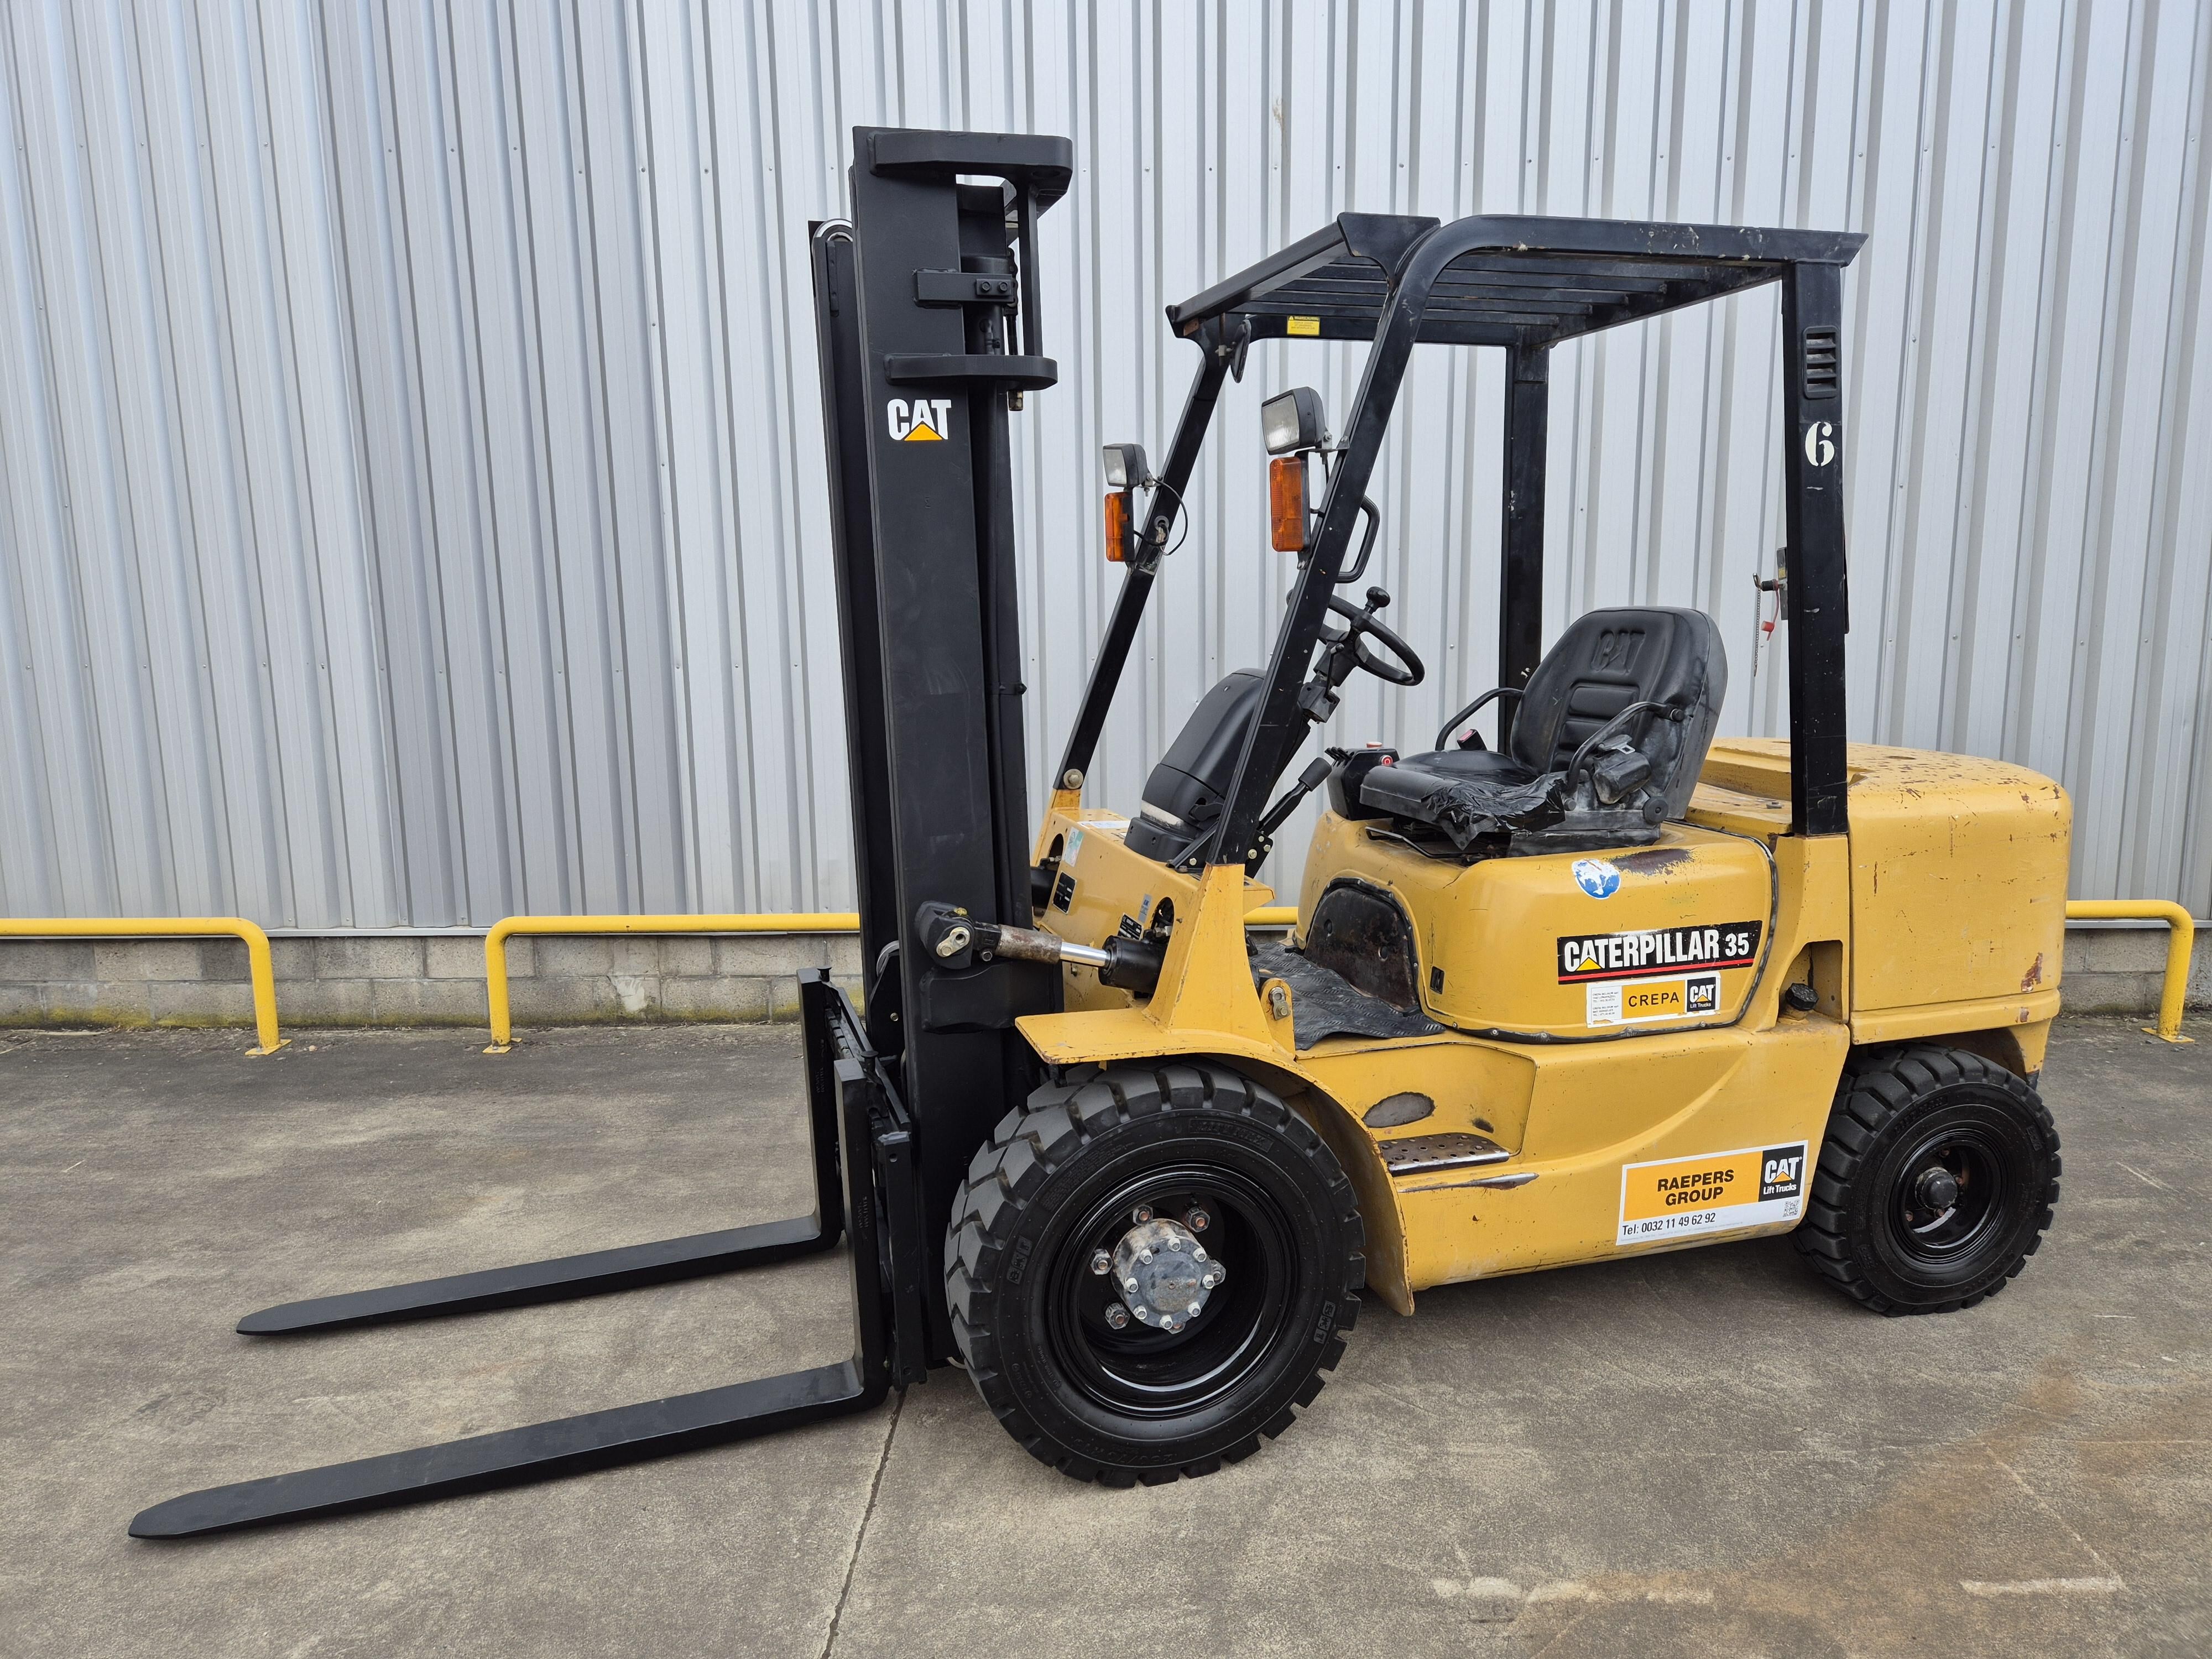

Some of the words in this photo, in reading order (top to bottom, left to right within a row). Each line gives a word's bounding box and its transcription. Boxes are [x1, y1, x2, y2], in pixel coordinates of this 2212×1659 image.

[886, 398, 952, 441] CAT
[1805, 421, 1835, 467] 6
[1590, 628, 1646, 675] CAT
[1564, 929, 1720, 972] CATERPILLAR
[1725, 932, 1750, 957] 35
[1629, 992, 1679, 1007] CREPA
[1689, 984, 1714, 1003] CAT
[1657, 1169, 1734, 1192] RAEPERS
[1764, 1157, 1799, 1183] CAT
[1665, 1186, 1724, 1206] GROUP
[1763, 1185, 1774, 1195] Lift
[1775, 1183, 1797, 1193] Trucks
[1623, 1225, 1639, 1235] Tel:
[1641, 1220, 1663, 1233] 0032
[1666, 1218, 1675, 1229] 11
[1678, 1217, 1689, 1227] 49
[1692, 1214, 1703, 1225] 62
[1705, 1212, 1716, 1223] 92
